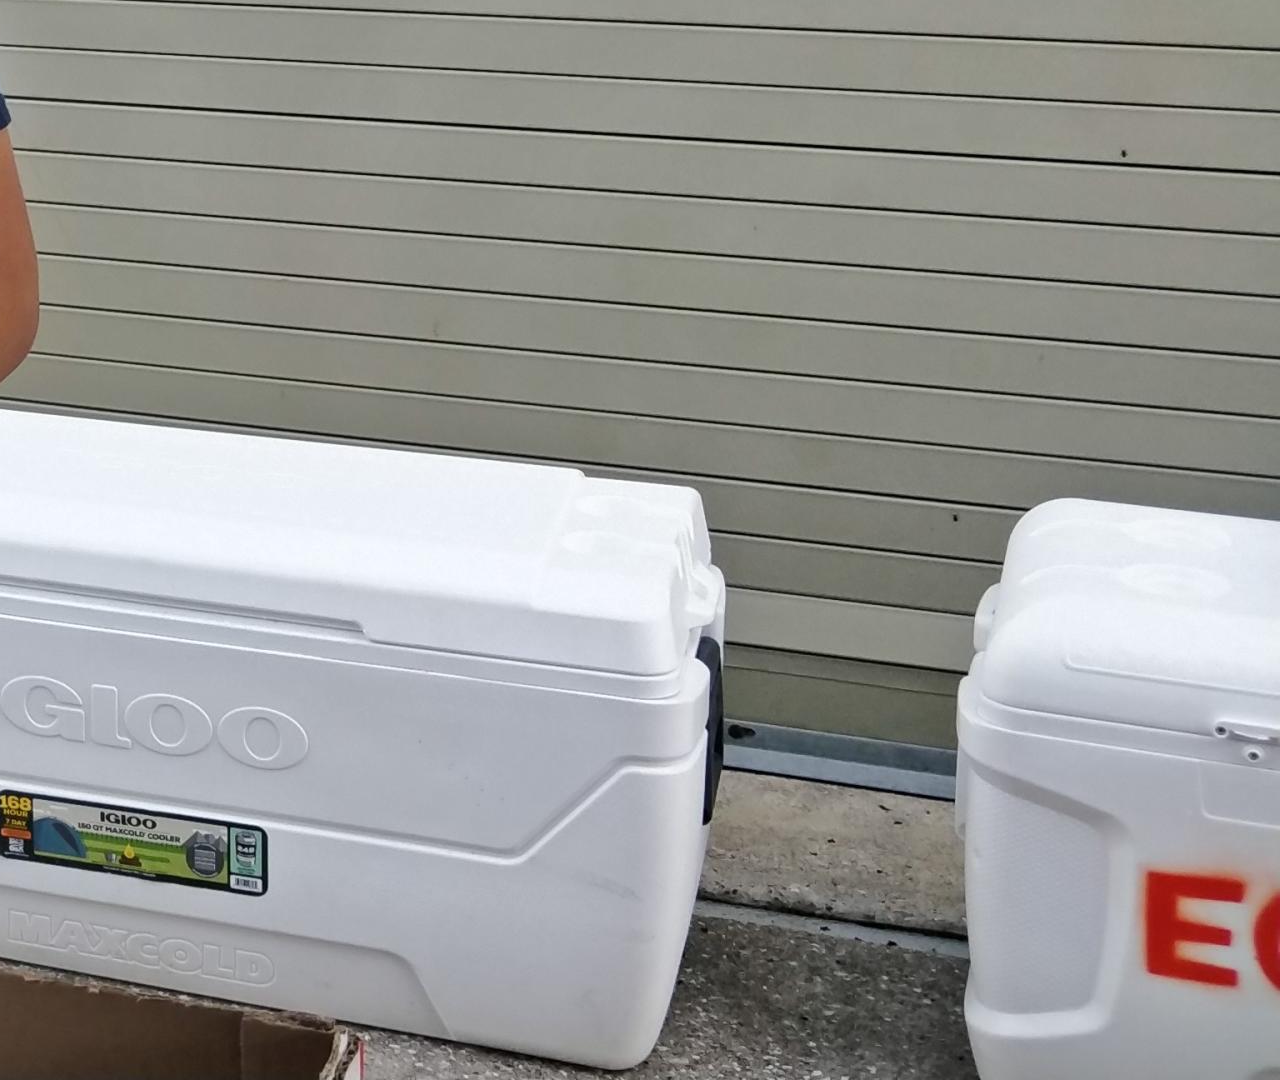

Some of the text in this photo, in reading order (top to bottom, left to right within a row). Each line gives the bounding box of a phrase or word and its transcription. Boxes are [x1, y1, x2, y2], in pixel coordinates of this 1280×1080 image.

[0, 794, 32, 811] 168
[3, 808, 29, 818] HOUR
[100, 811, 157, 830] IGLOO
[147, 832, 181, 843] COOLER
[7, 910, 277, 987] MAXCOLD
